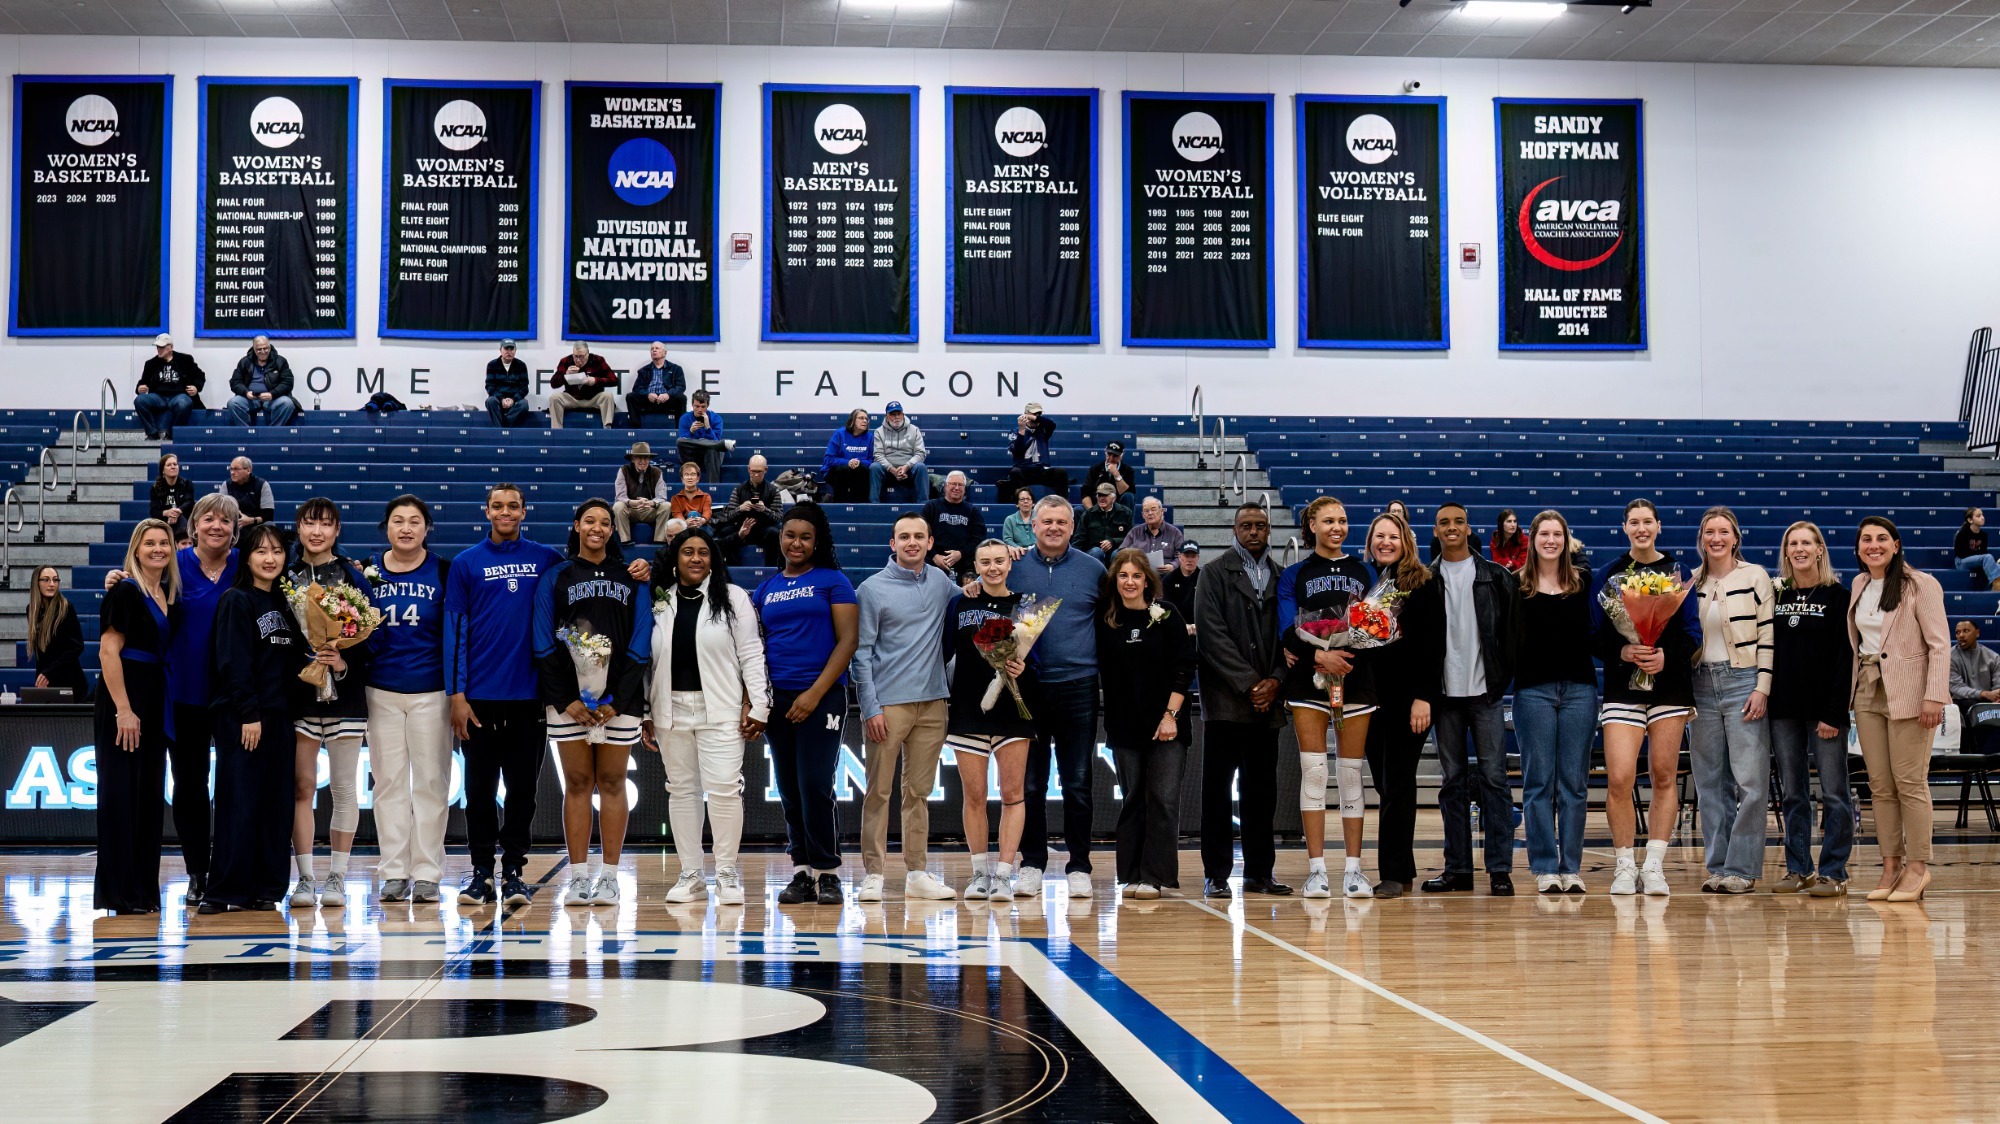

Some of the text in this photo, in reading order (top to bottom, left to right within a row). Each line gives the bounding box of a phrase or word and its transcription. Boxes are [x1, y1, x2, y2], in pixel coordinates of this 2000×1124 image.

[605, 98, 681, 111] WOMEN'S
[71, 120, 116, 132] NCAA
[591, 115, 695, 128] BASKETBALL
[1535, 116, 1602, 133] SANDY
[255, 122, 302, 135] NCAA
[440, 124, 484, 137] NCAA
[820, 128, 865, 141] NCAA
[1001, 131, 1044, 144] NCAA
[1178, 136, 1221, 149] NCAA
[1351, 138, 1394, 151] NCAA
[1520, 141, 1618, 159] HOFFMAN
[48, 153, 136, 167] WOMEN'S
[233, 155, 321, 169] WOMEN'S
[416, 158, 504, 172] WOMEN'S
[813, 162, 869, 176] MEN'S
[994, 164, 1049, 177] MEN'S
[34, 170, 149, 183] BASKETBALL
[220, 172, 334, 185] BASKETBALL
[403, 174, 517, 188] BASKETBALL
[615, 170, 674, 189] NCAA
[1156, 170, 1241, 183] WOMEN'S
[1330, 171, 1415, 185] WOMEN'S
[784, 177, 898, 192] BASKETBALL
[966, 180, 1077, 193] BASKETBALL
[36, 193, 117, 203] 2023 2024 2025
[1144, 185, 1253, 198] VOLLEYBALL
[1319, 186, 1426, 201] VOLLEYBALL
[216, 197, 337, 207] FINAL FOUR 1989
[400, 201, 519, 212] FINAL FOUR 2003
[788, 201, 894, 212] 1972 1973 1974 1975
[216, 211, 336, 221] NATIONAL RUNNER-UP 1990
[963, 207, 1080, 218] ELITE EIGHT 2007
[1147, 209, 1250, 219] 1993 1995 1998 2001
[1536, 200, 1620, 221] avca
[400, 215, 518, 226] ELITE EIGHT 2011
[788, 215, 894, 226] 1976 1979 1985 1989
[1317, 213, 1429, 225] ELITE EIGHT 2023
[216, 225, 335, 235] FINAL FOUR 1991
[597, 220, 687, 235] DIVISION II
[963, 221, 1080, 231] FINAL FOUR 2008
[1147, 222, 1251, 233] 2002 2004 2005 2006
[1317, 227, 1429, 238] FINAL FOUR 2024
[1534, 222, 1619, 230] AMERICAN VOLLEYBALL
[400, 229, 519, 240] FINAL FOUR 2012
[788, 229, 894, 240] 1993 2002 2005 2006
[963, 235, 1080, 245] FINAL FOUR 2010
[1533, 230, 1619, 238] COACHES ASSOCIATION
[216, 239, 336, 249] FINAL FOUR 1992
[1147, 236, 1251, 246] 2007 2008 2009 2014
[400, 244, 518, 254] NATIONAL CHAMPIONS 2014
[584, 238, 700, 258] NATIONAL
[787, 243, 894, 254] 2007 2008 2009 2010
[963, 249, 1080, 259] ELITE EIGHT 2022
[215, 253, 336, 262] FINAL FOUR 1993
[1147, 250, 1251, 260] 2019 2021 2022 2023
[400, 258, 518, 268] FINAL FOUR 2016
[787, 257, 894, 268] 2011 2016 2022 2023
[1147, 264, 1167, 273] 2024
[399, 271, 518, 282] ELITE EIGHT 2025
[576, 261, 707, 281] CHAMPIONS
[215, 280, 336, 290] FINAL FOUR 1997
[1525, 289, 1621, 301] HALL OF FAME
[612, 299, 671, 319] 2014
[1540, 306, 1607, 318] INDUCTEE
[1558, 323, 1589, 335] 2014
[775, 369, 1064, 395] FALCONS
[484, 564, 537, 577] BENTLEY
[568, 580, 631, 606] BENTLEY
[1305, 575, 1365, 599] BENTLEY
[385, 604, 420, 627] 14
[825, 713, 841, 730] M
